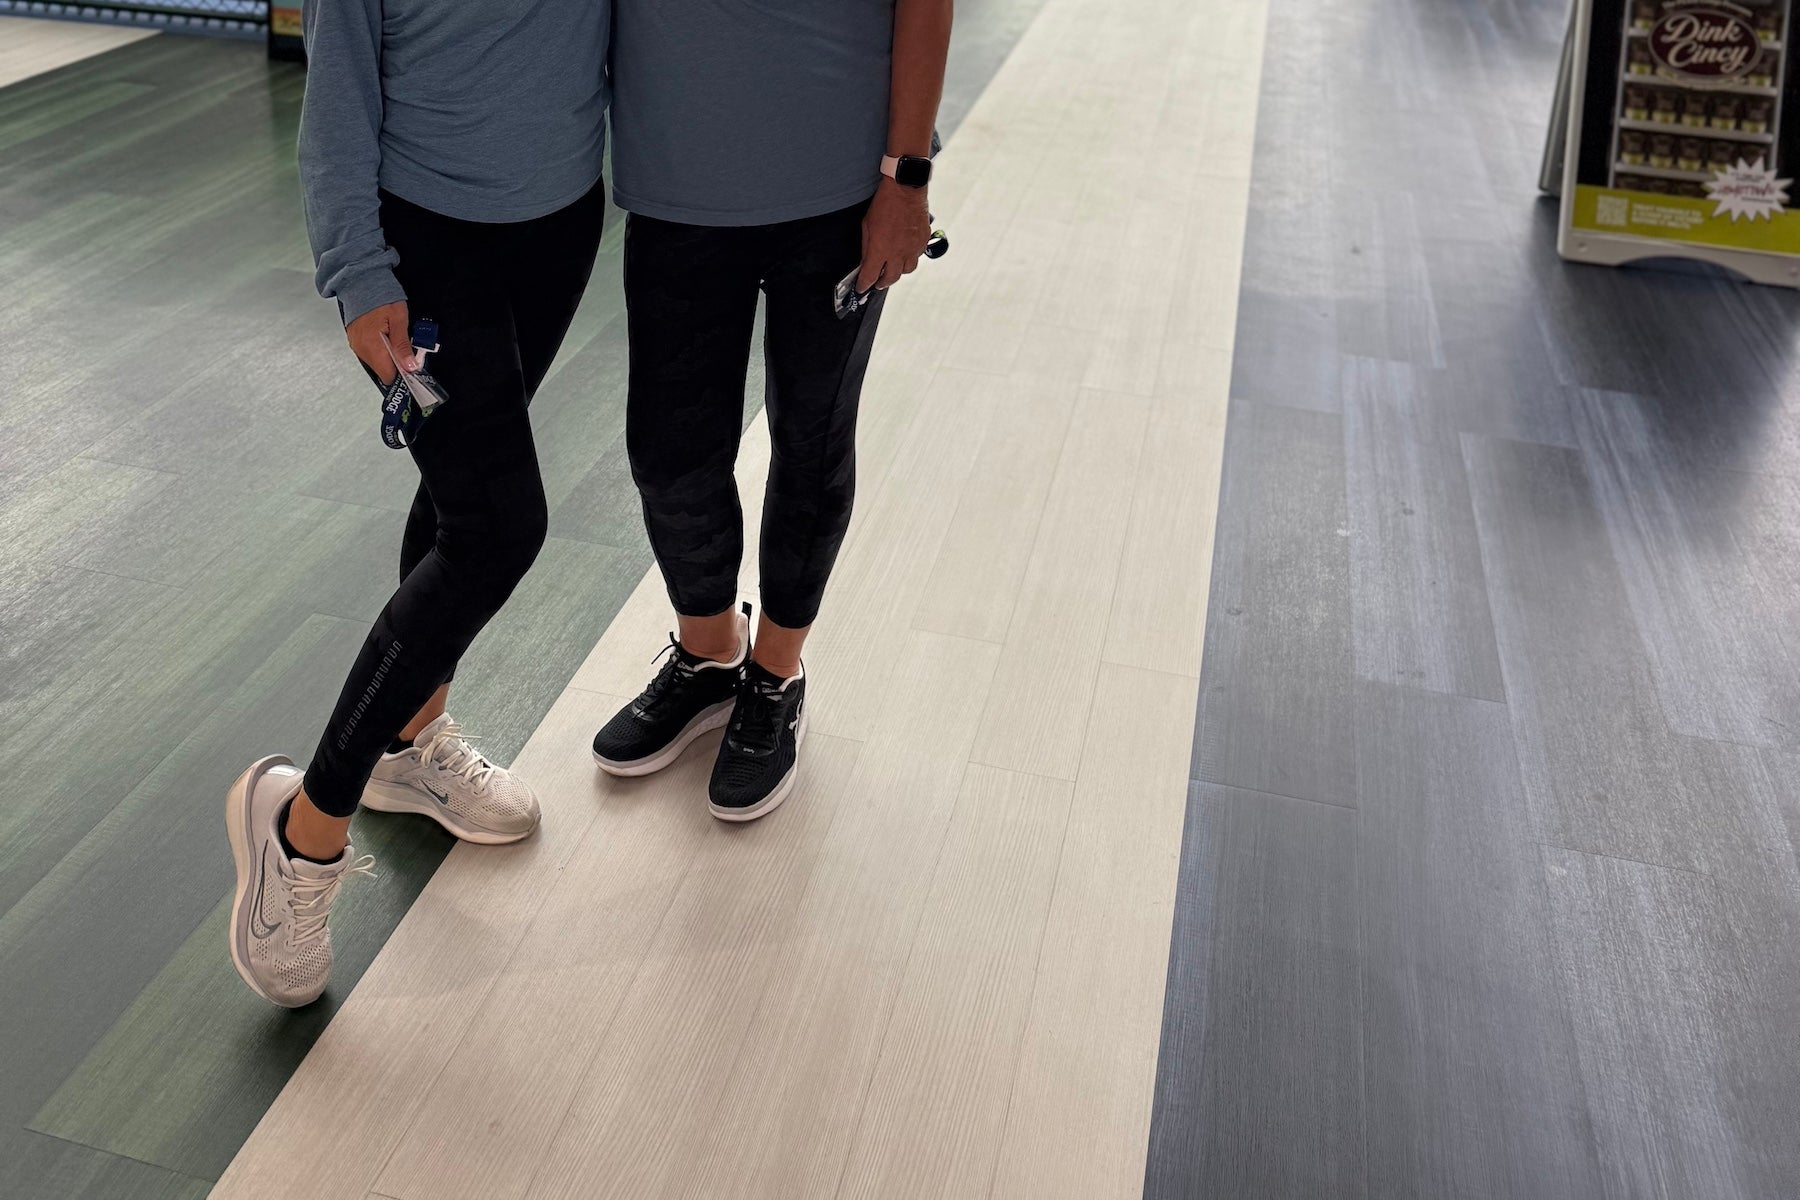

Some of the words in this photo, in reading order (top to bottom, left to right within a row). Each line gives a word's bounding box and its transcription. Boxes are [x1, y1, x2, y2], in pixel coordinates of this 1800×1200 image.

[1660, 13, 1743, 43] Dink
[1668, 41, 1749, 74] Cincy
[386, 388, 406, 414] LODGE
